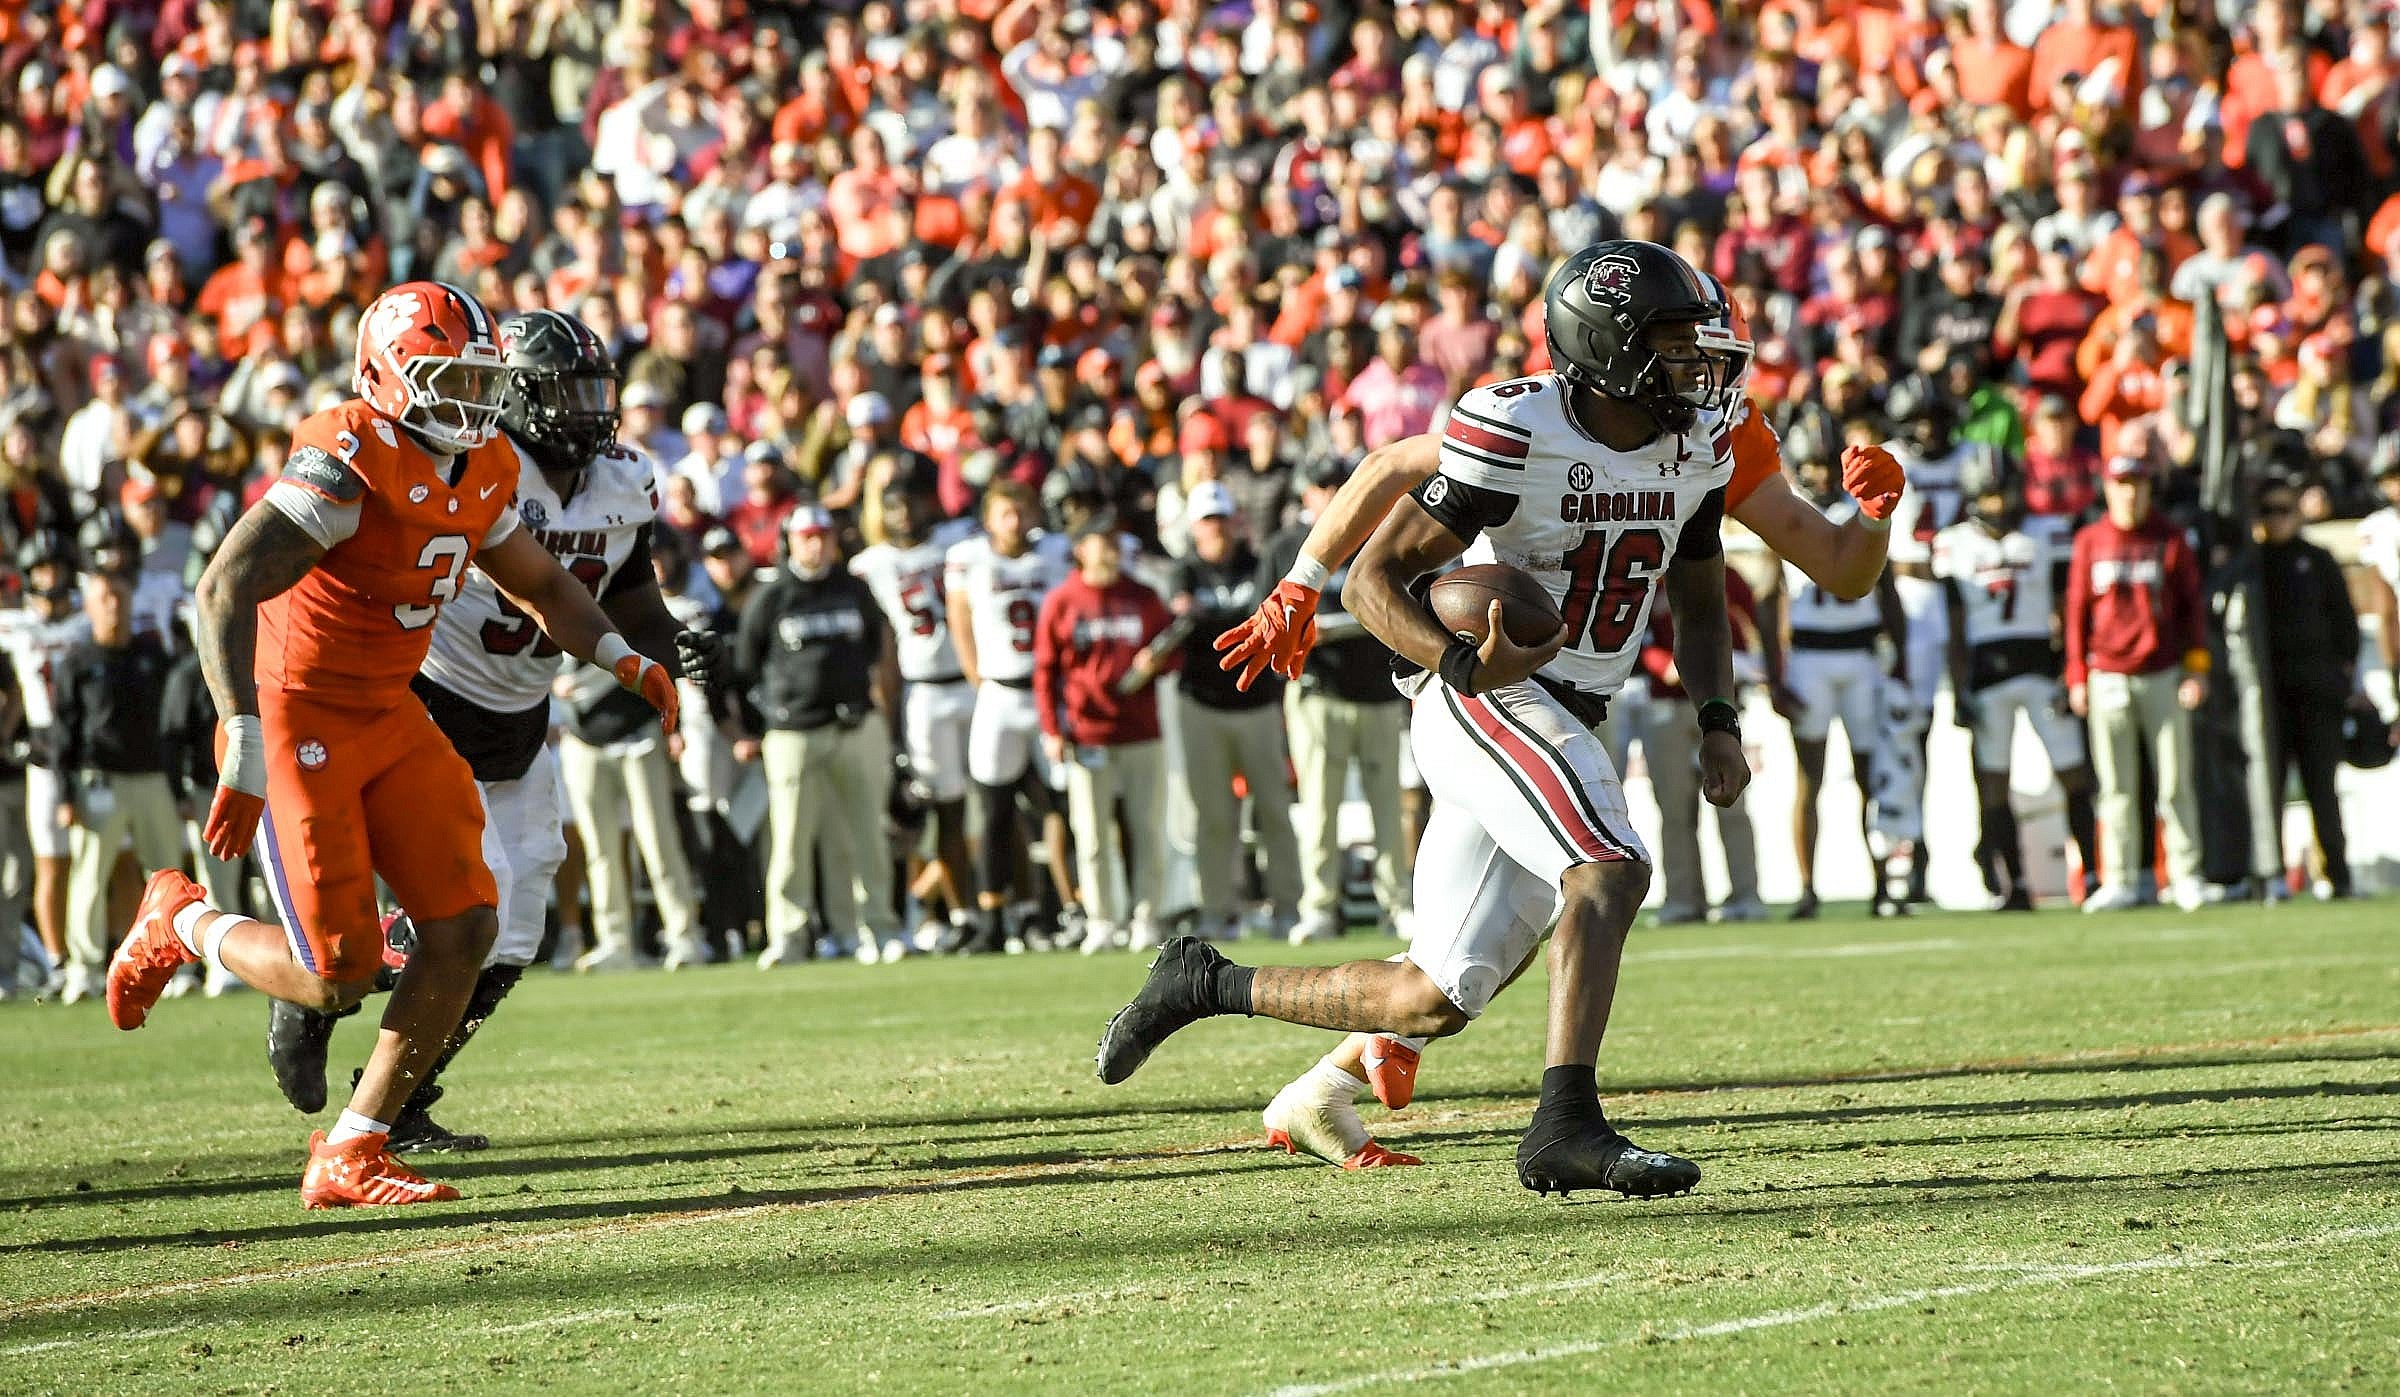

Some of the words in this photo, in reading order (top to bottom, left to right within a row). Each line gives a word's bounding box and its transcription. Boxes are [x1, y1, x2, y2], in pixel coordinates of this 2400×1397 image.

[1571, 464, 1592, 488] SEC
[1560, 490, 1676, 522] CAROLINA
[393, 534, 469, 630] 3
[1559, 528, 1666, 653] 16
[1986, 578, 2014, 622] 7
[1007, 599, 1037, 652] 9
